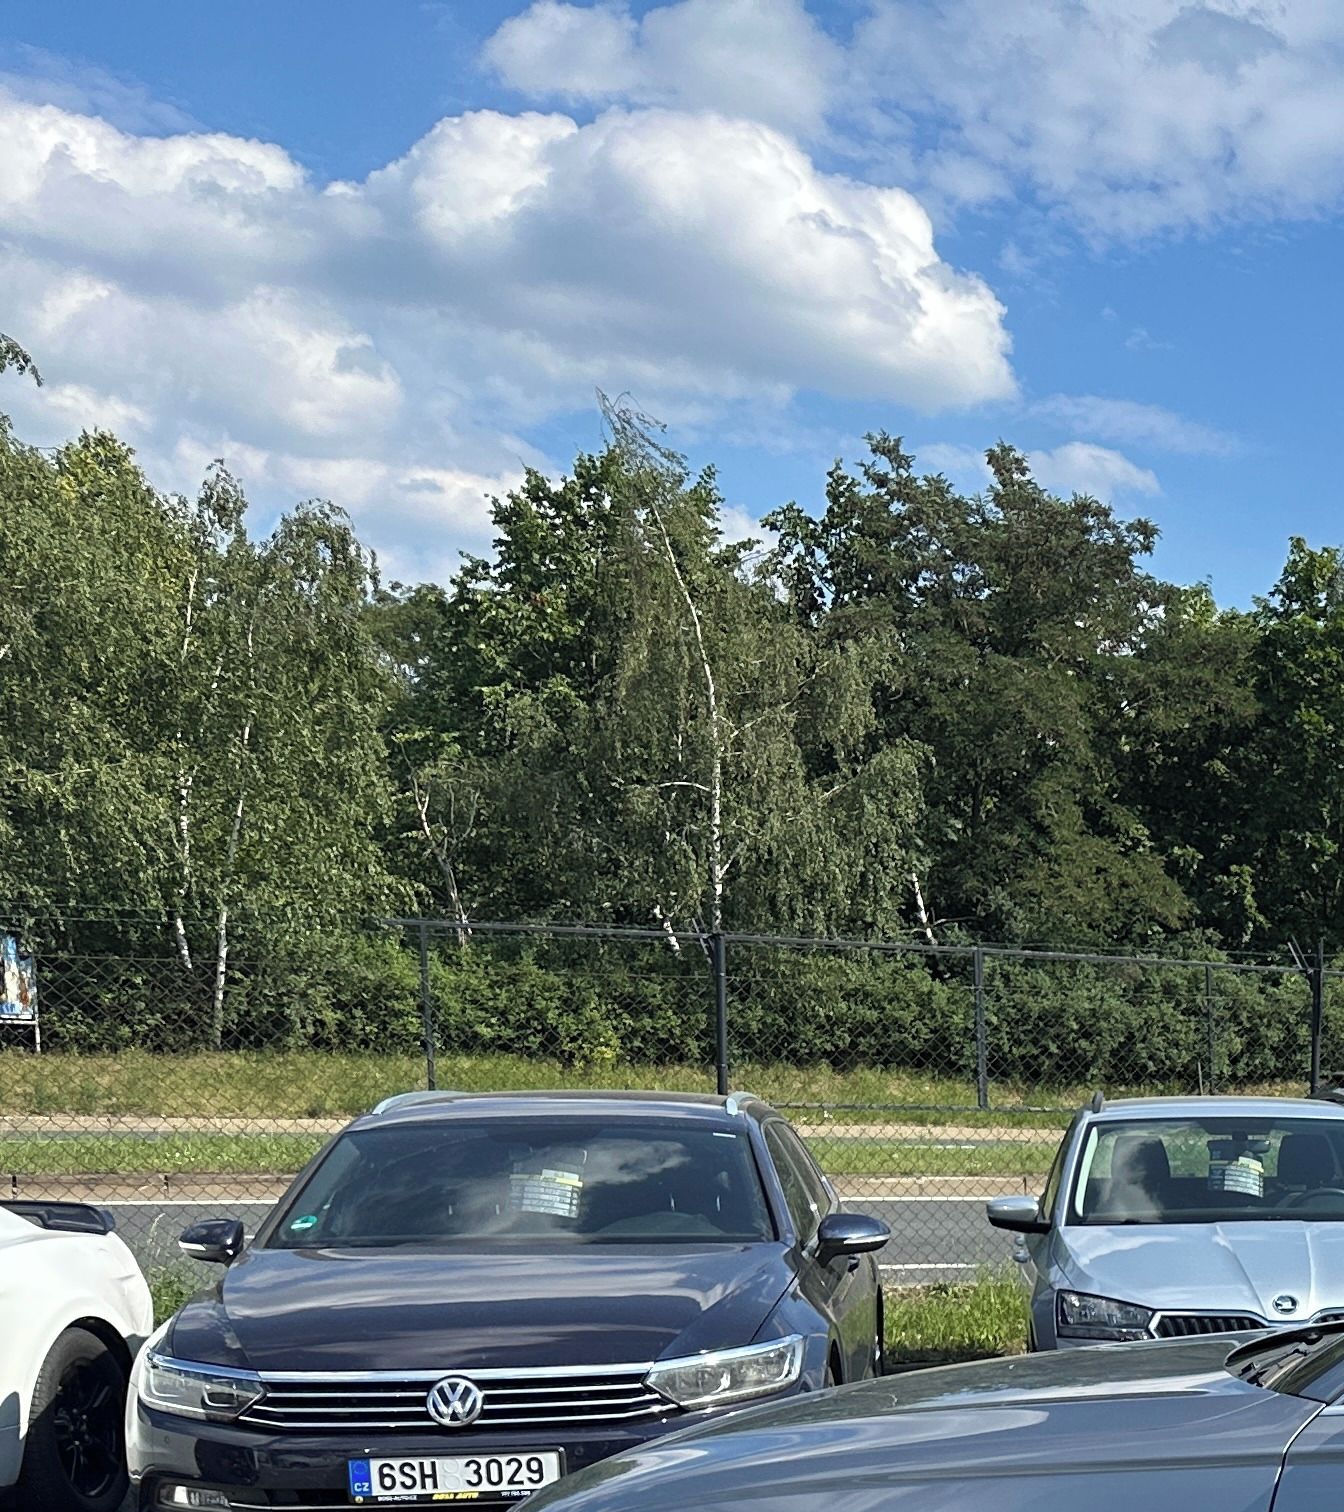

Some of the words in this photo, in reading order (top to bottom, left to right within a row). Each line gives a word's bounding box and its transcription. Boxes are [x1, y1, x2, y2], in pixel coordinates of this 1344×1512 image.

[378, 1460, 439, 1491] 6SH
[464, 1456, 545, 1488] 3029
[354, 1481, 370, 1492] CZ
